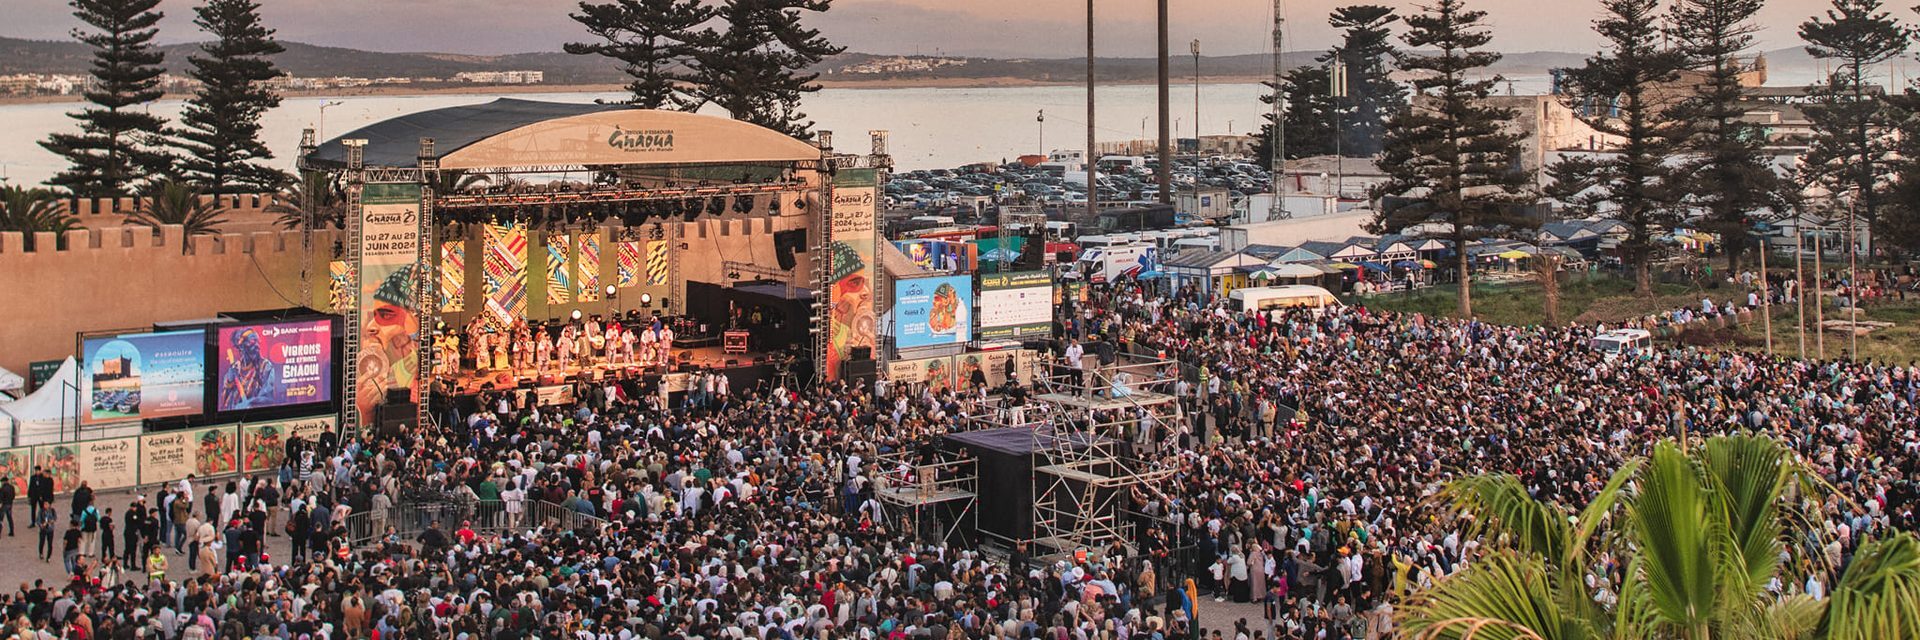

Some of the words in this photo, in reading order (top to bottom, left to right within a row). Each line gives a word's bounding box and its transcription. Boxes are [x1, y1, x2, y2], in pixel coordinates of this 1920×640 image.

[404, 232, 416, 240] 29
[391, 242, 415, 250] 2024
[281, 343, 321, 358] VIBRONS
[282, 363, 319, 378] GNAOUI
